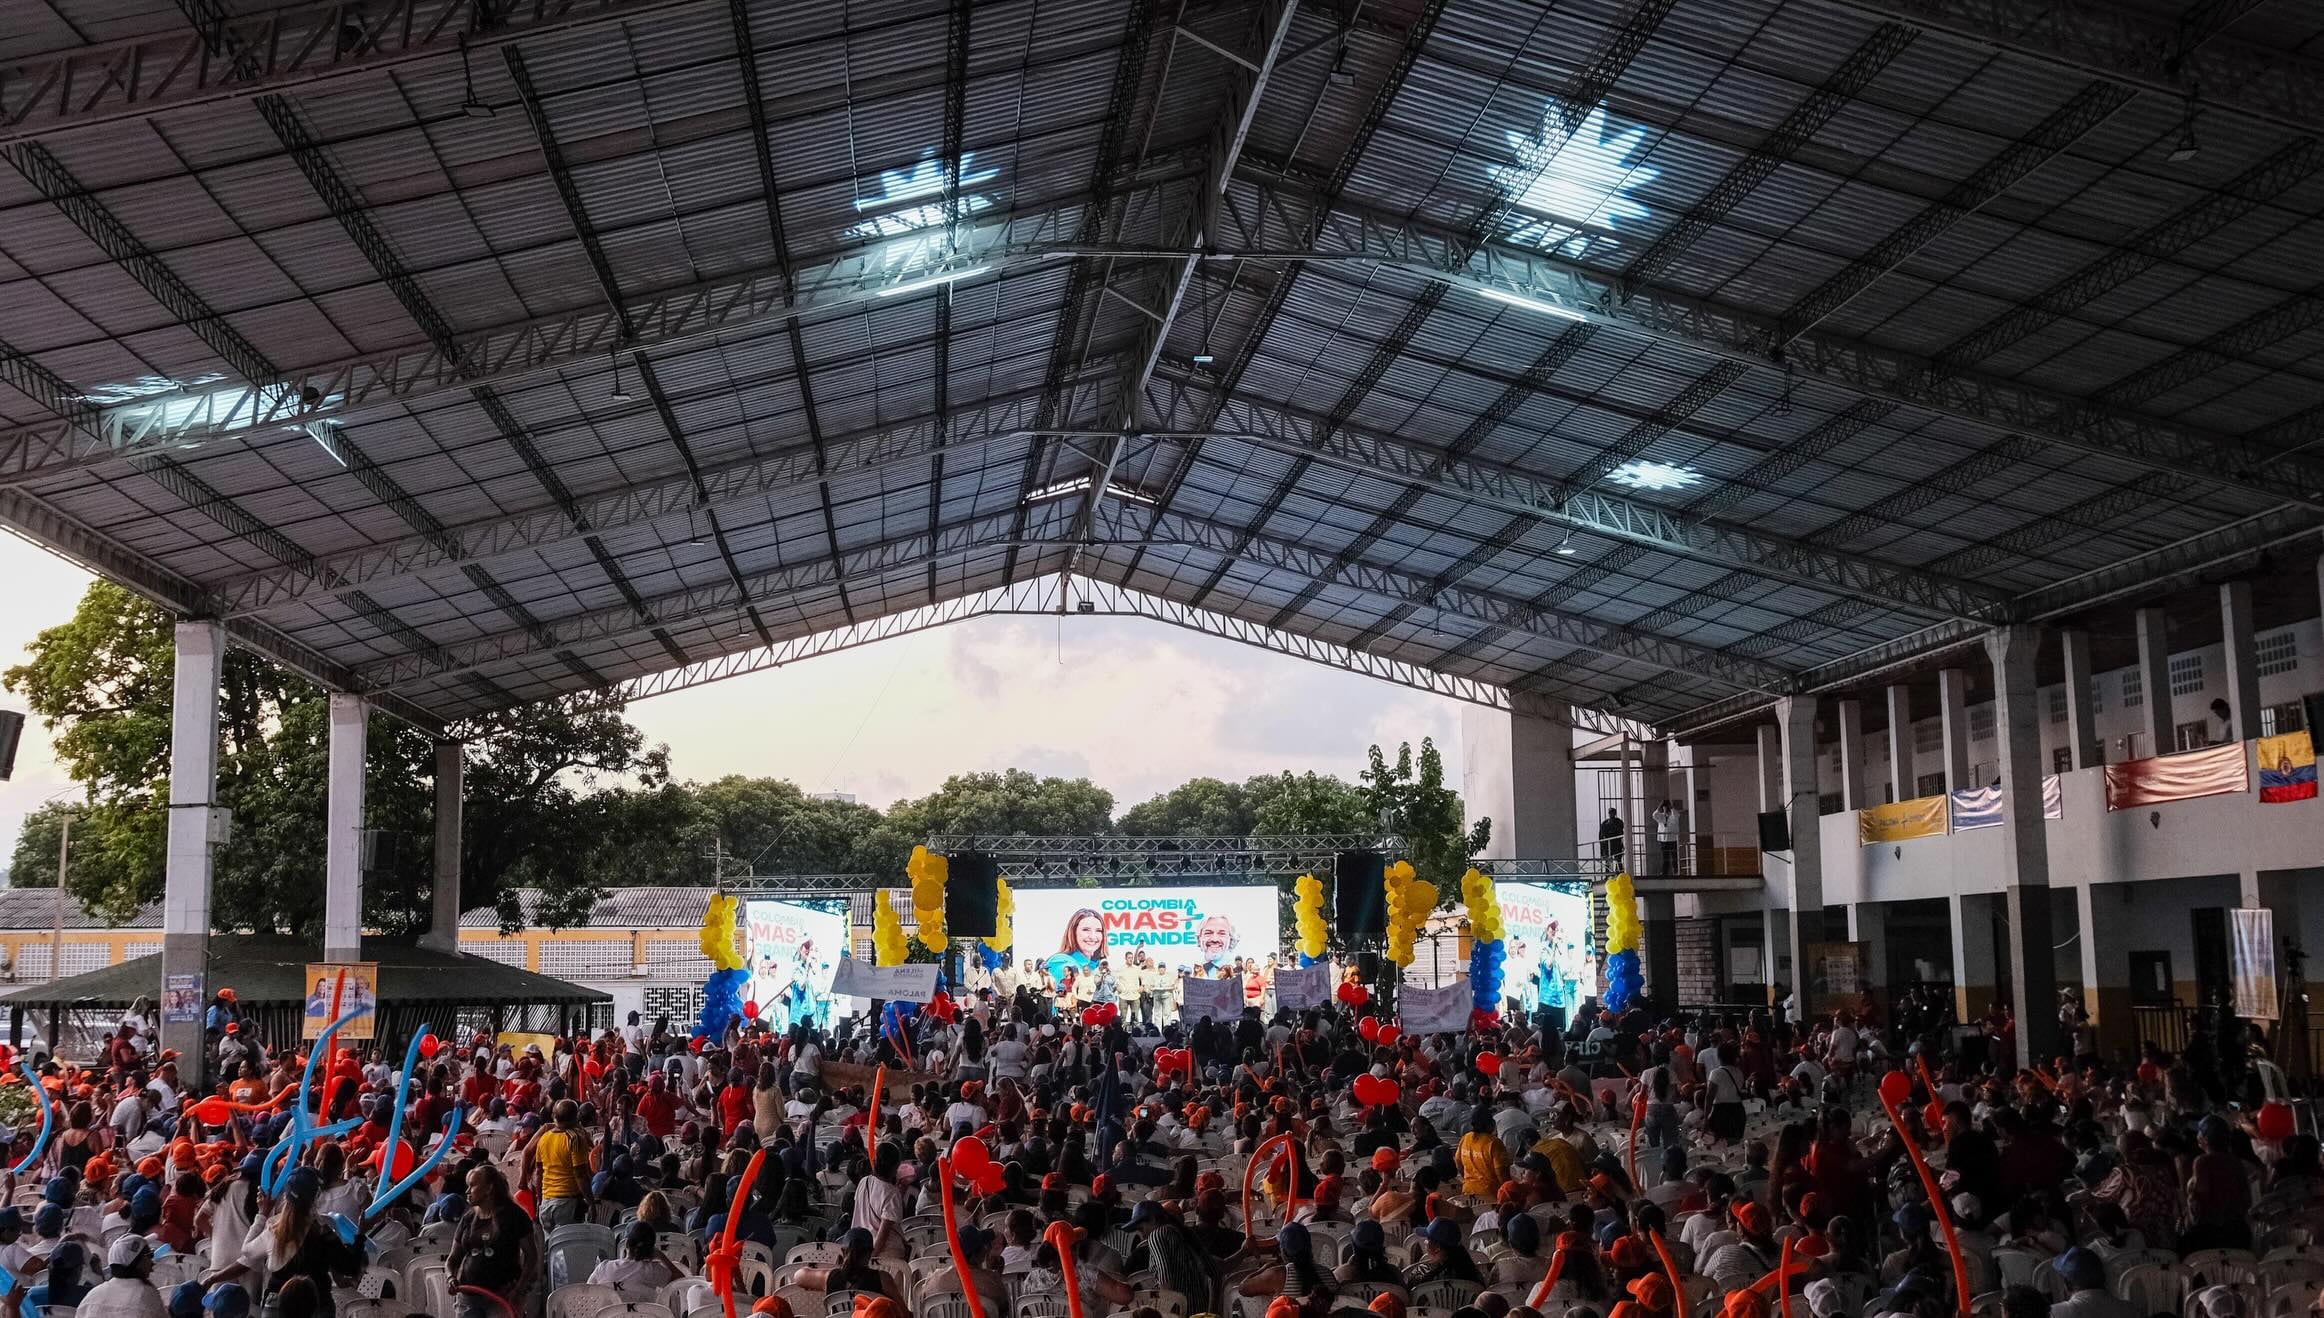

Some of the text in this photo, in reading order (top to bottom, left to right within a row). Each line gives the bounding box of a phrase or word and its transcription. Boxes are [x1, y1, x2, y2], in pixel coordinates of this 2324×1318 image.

[1102, 899, 1196, 910] COLOMBIA
[1103, 908, 1179, 930] MÁS
[1107, 932, 1196, 946] GRANDE
[613, 1281, 624, 1291] K
[950, 1292, 960, 1301] K
[627, 1303, 637, 1312] K
